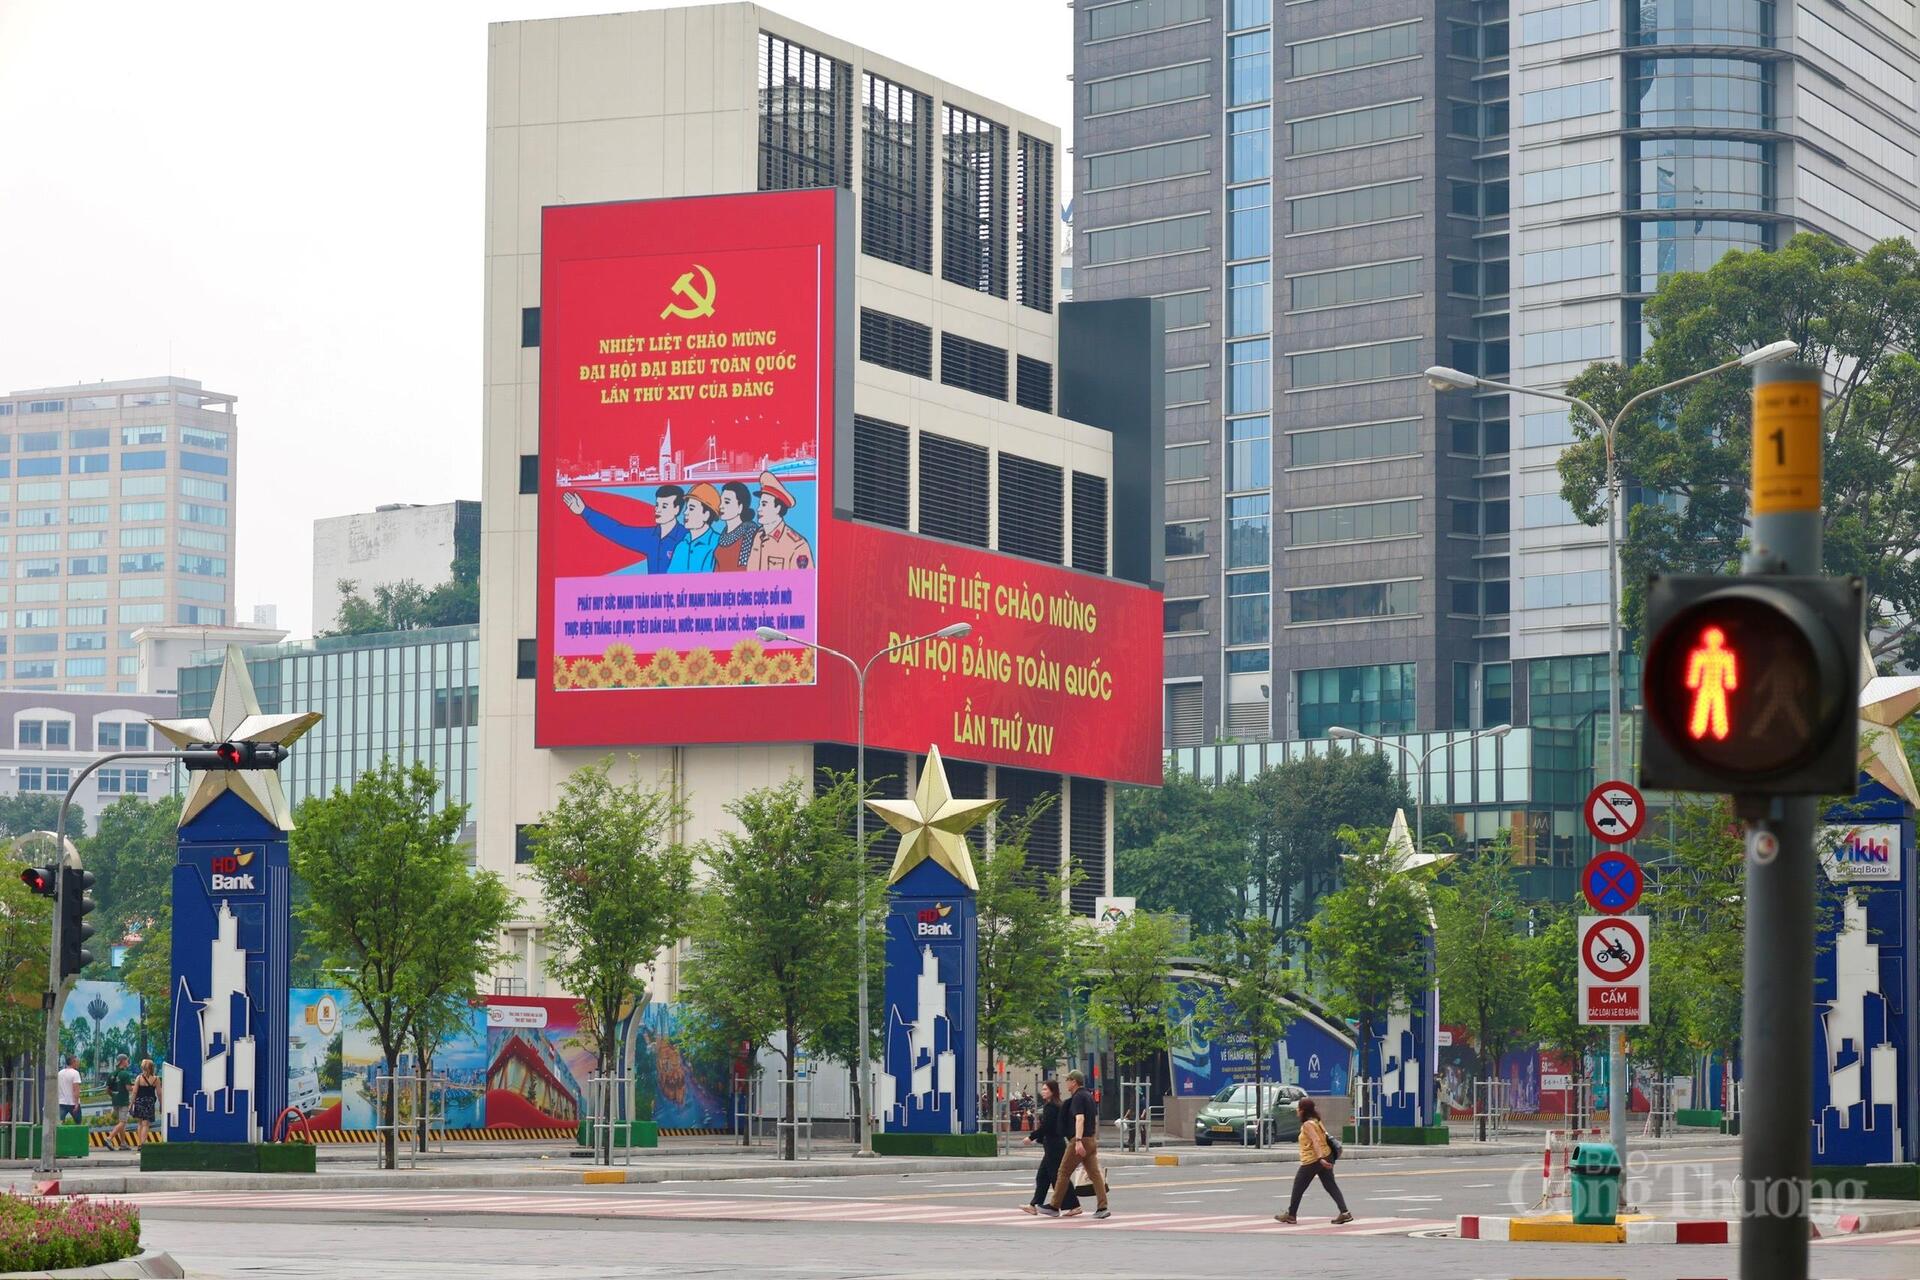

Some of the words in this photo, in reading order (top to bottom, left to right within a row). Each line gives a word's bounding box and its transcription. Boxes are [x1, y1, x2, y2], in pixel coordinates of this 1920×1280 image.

[599, 334, 645, 357] NHIỆT
[649, 332, 682, 355] LIỆT
[686, 330, 727, 350] CHÀO
[732, 328, 776, 347] MỪNG
[580, 364, 605, 383] ĐẠI
[609, 359, 637, 382] HỘI
[641, 361, 667, 380] ĐẠI
[671, 353, 705, 376] BIỂU
[710, 354, 750, 374] TOÀN
[755, 349, 796, 375] QUỐC
[601, 383, 629, 404] LẦN
[634, 383, 664, 402] THỨ
[667, 386, 695, 401] XIV
[699, 379, 728, 399] CỦA
[732, 378, 774, 398] ĐẢNG
[1768, 427, 1786, 466] 1
[908, 563, 956, 613] NHIỆT
[961, 571, 991, 620] LIỆT
[995, 581, 1045, 623] CHÀO
[1049, 590, 1097, 633] MỪNG
[888, 631, 919, 675] ĐẠI
[925, 636, 957, 682] HỘI
[962, 635, 1012, 683] ĐẢNG
[1016, 650, 1060, 692] TOÀN
[1064, 658, 1113, 701] QUỐC
[954, 697, 986, 746] LẦN
[990, 711, 1022, 751] THỨ
[1026, 723, 1054, 756] XIV
[211, 857, 238, 873] HD
[1865, 865, 1887, 873] Bank
[212, 873, 255, 890] Bank
[917, 909, 940, 923] HD
[917, 922, 953, 936] Bank
[1600, 987, 1627, 1004] CẤM
